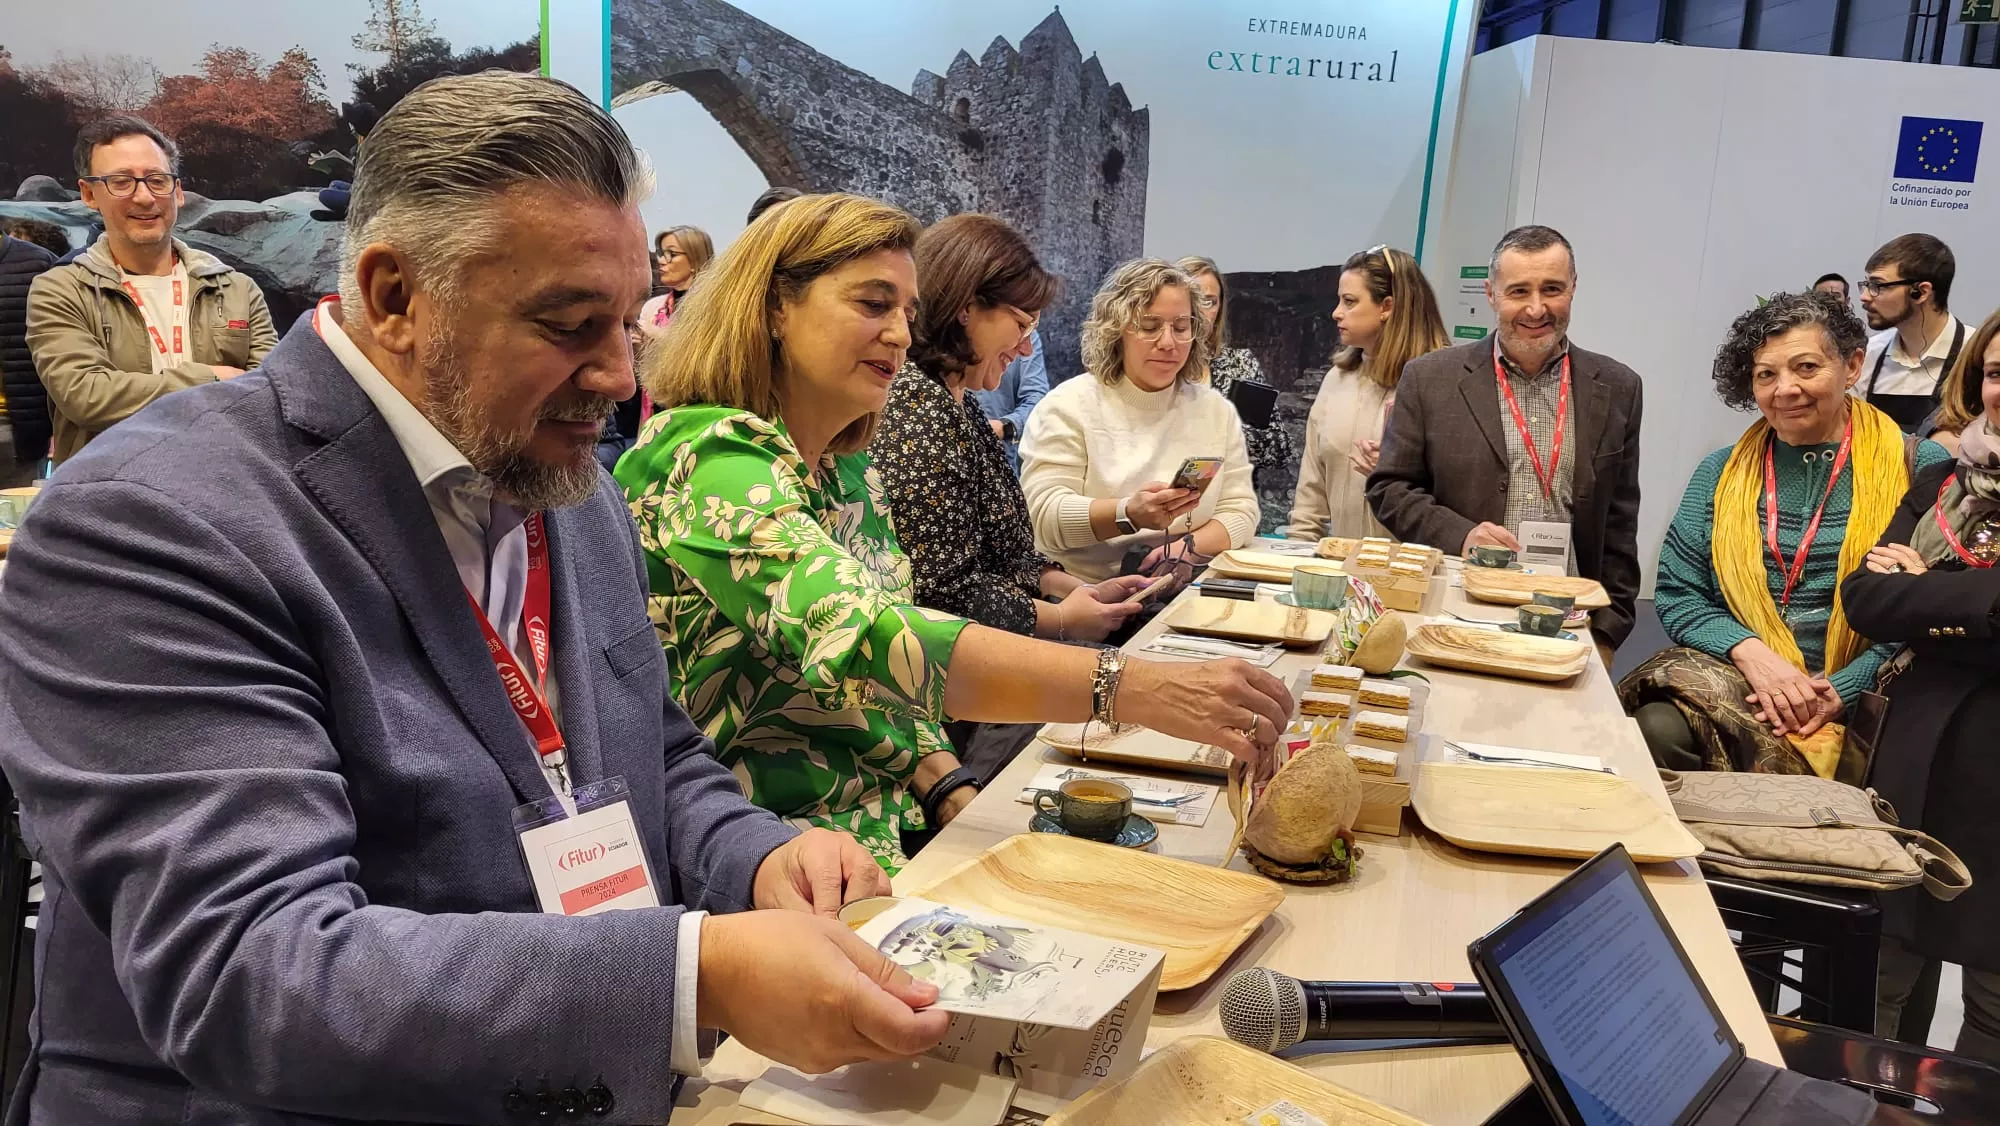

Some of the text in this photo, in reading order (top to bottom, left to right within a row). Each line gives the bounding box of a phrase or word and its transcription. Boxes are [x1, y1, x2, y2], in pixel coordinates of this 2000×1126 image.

[1248, 18, 1367, 40] EXTREMADURA
[1207, 49, 1399, 83] extrarural
[1892, 183, 1971, 198] Cofinanciado por
[1890, 196, 1969, 210] la Unión Europea
[529, 627, 545, 668] Fitur
[501, 669, 534, 710] Fitur
[567, 847, 598, 868] Fitur
[581, 874, 629, 898] PRENSA FITUR
[599, 889, 617, 901] 2024
